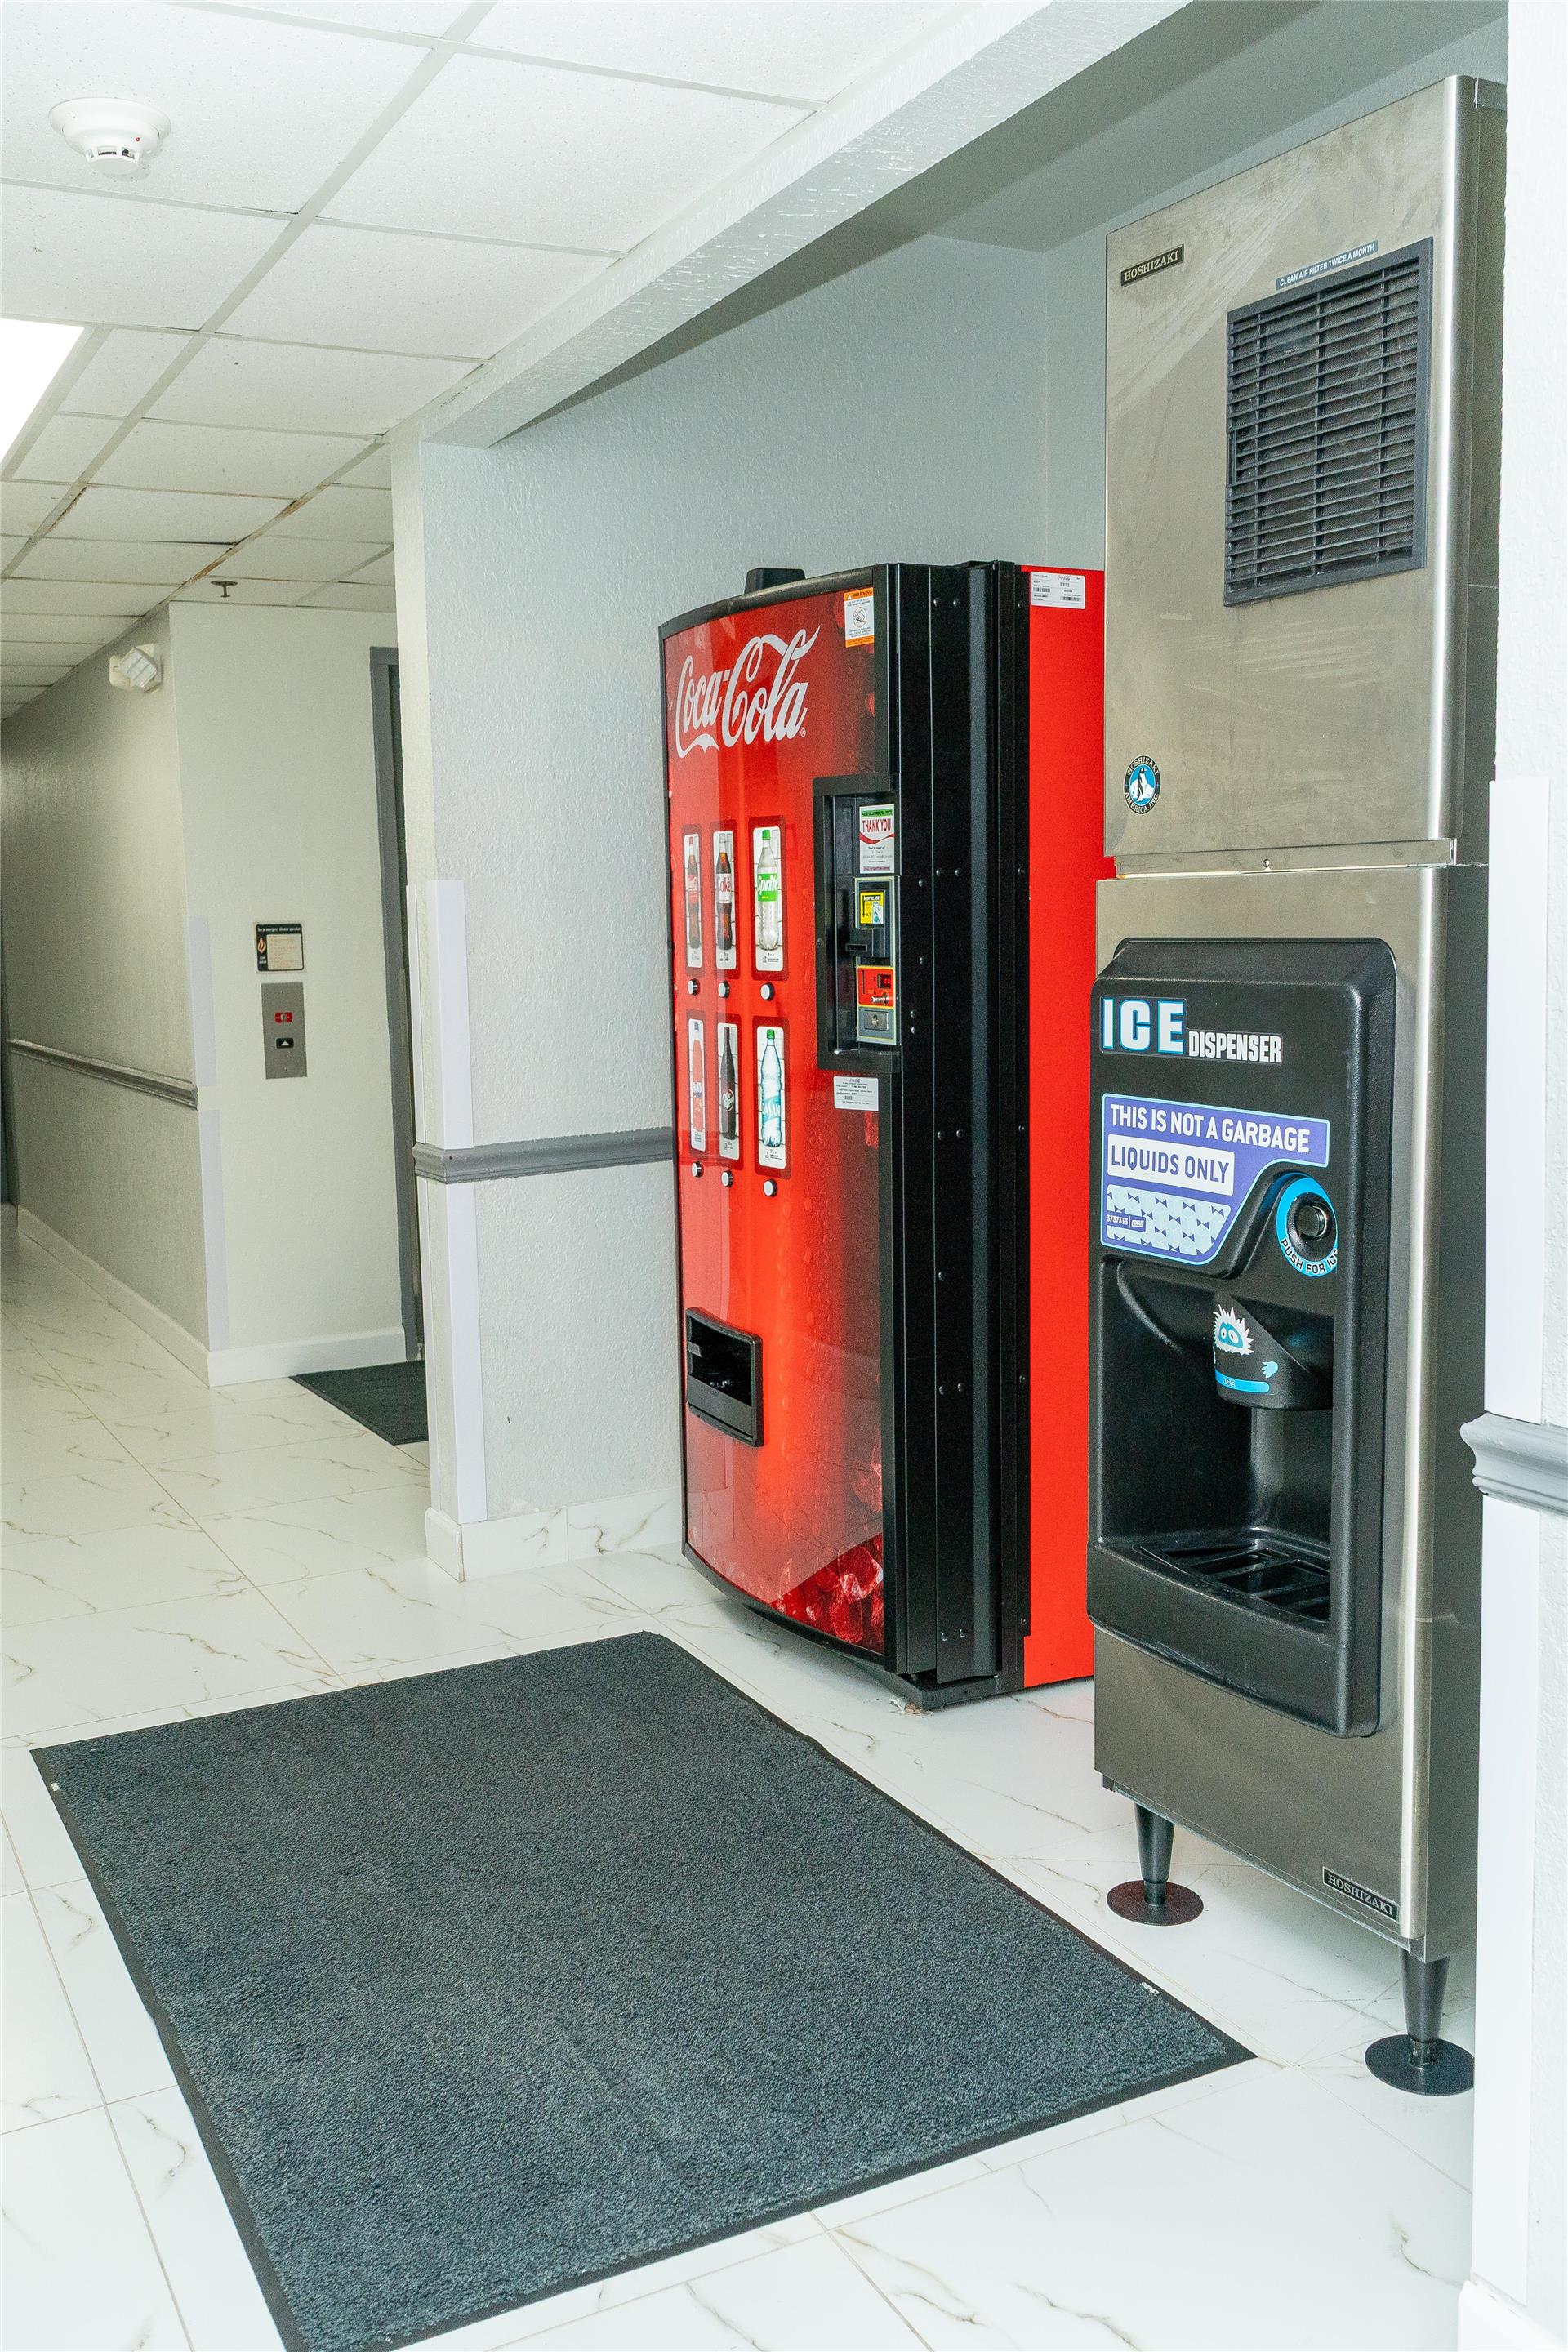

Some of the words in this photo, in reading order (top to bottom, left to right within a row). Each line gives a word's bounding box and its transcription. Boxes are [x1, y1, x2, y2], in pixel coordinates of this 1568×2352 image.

[1124, 250, 1178, 283] HOSHIZAKI
[1279, 273, 1298, 287] CLEAN
[1298, 270, 1308, 278] AIR
[1309, 261, 1328, 275] FILTER
[1328, 254, 1347, 268] TWICE
[1352, 243, 1374, 258] MONTH
[675, 624, 822, 759] Coca-Cola
[1127, 756, 1159, 775] HOSHIZAKI
[862, 820, 880, 832] THANK
[880, 818, 891, 831] YOU
[1102, 998, 1184, 1054] ICE
[1188, 1031, 1281, 1062] DISPENSER
[1110, 1103, 1147, 1129] THIS
[1151, 1108, 1167, 1132] IS
[1170, 1111, 1205, 1137] NOT
[1205, 1116, 1218, 1140] A
[1222, 1118, 1310, 1153] GARBAGE
[1111, 1145, 1179, 1175] LIQUIDS
[1184, 1156, 1230, 1183] ONLY
[1281, 1238, 1304, 1270] PUSH
[1306, 1263, 1325, 1274] FOR
[1327, 1873, 1394, 1916] HOSHIZAKI
